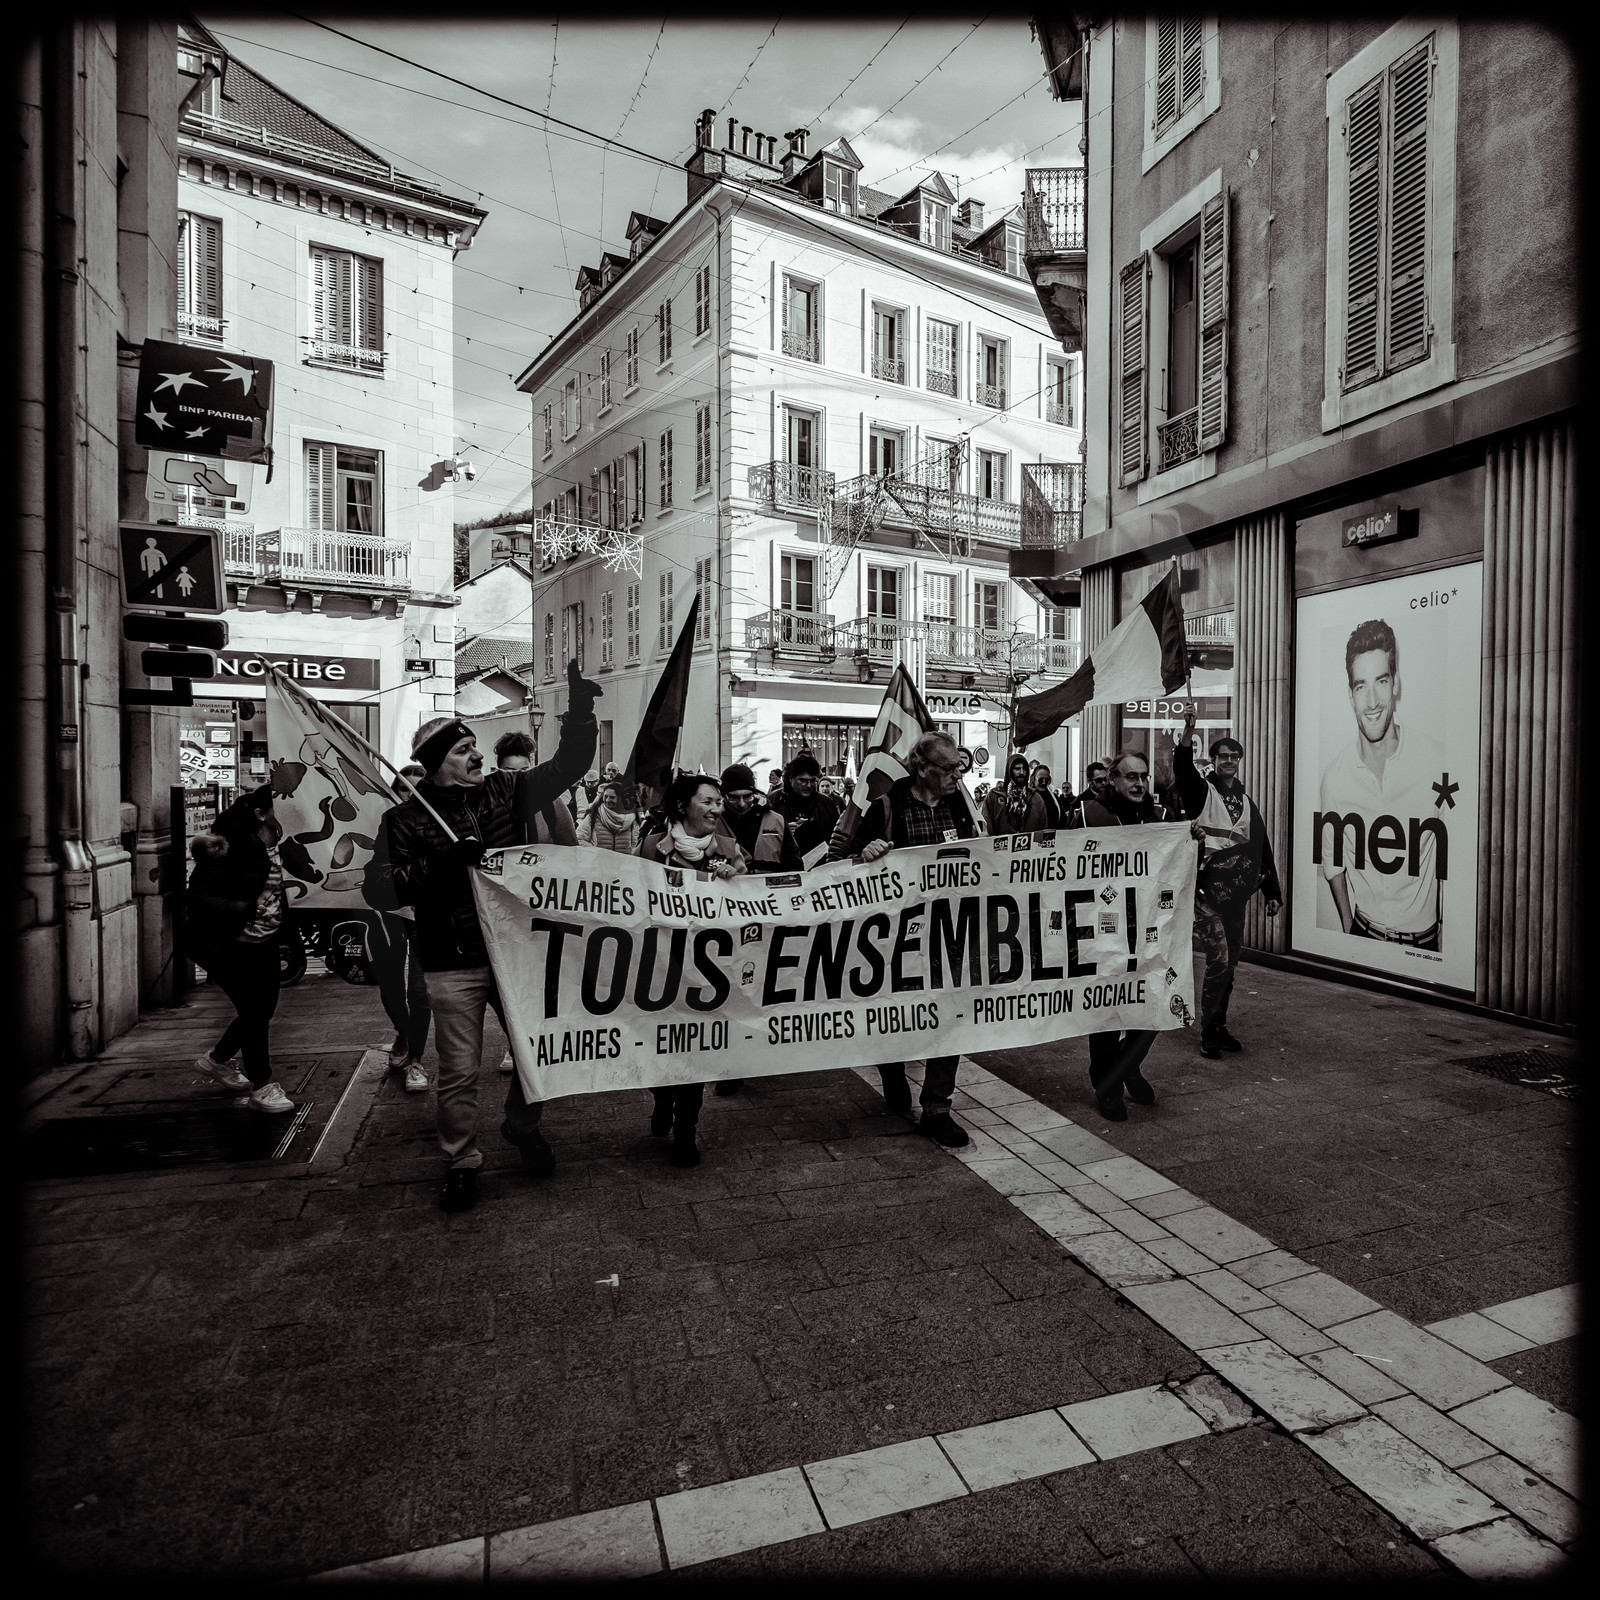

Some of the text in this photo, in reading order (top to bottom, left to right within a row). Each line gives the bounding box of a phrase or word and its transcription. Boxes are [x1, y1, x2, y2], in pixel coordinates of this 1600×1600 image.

[178, 404, 205, 414] BNP
[1015, 835, 1029, 847] FO
[529, 876, 635, 917] SALARIÉS
[811, 868, 905, 913] RETRAITÉS
[919, 861, 982, 892] JEUNES
[1009, 852, 1067, 884] PRIVÉS
[1076, 850, 1149, 880] D'EMPLOI
[744, 925, 759, 939] FO
[531, 917, 734, 1019] TOUS
[761, 888, 1097, 1007] ENSEMBLE
[529, 1027, 622, 1067] ALAIRES
[656, 1020, 730, 1055] EMPLOI
[767, 1010, 855, 1046] SERVICES
[866, 1002, 940, 1036] PUBLICS
[973, 989, 1074, 1025] PROTECTION
[1082, 979, 1147, 1011] SOCIALE
